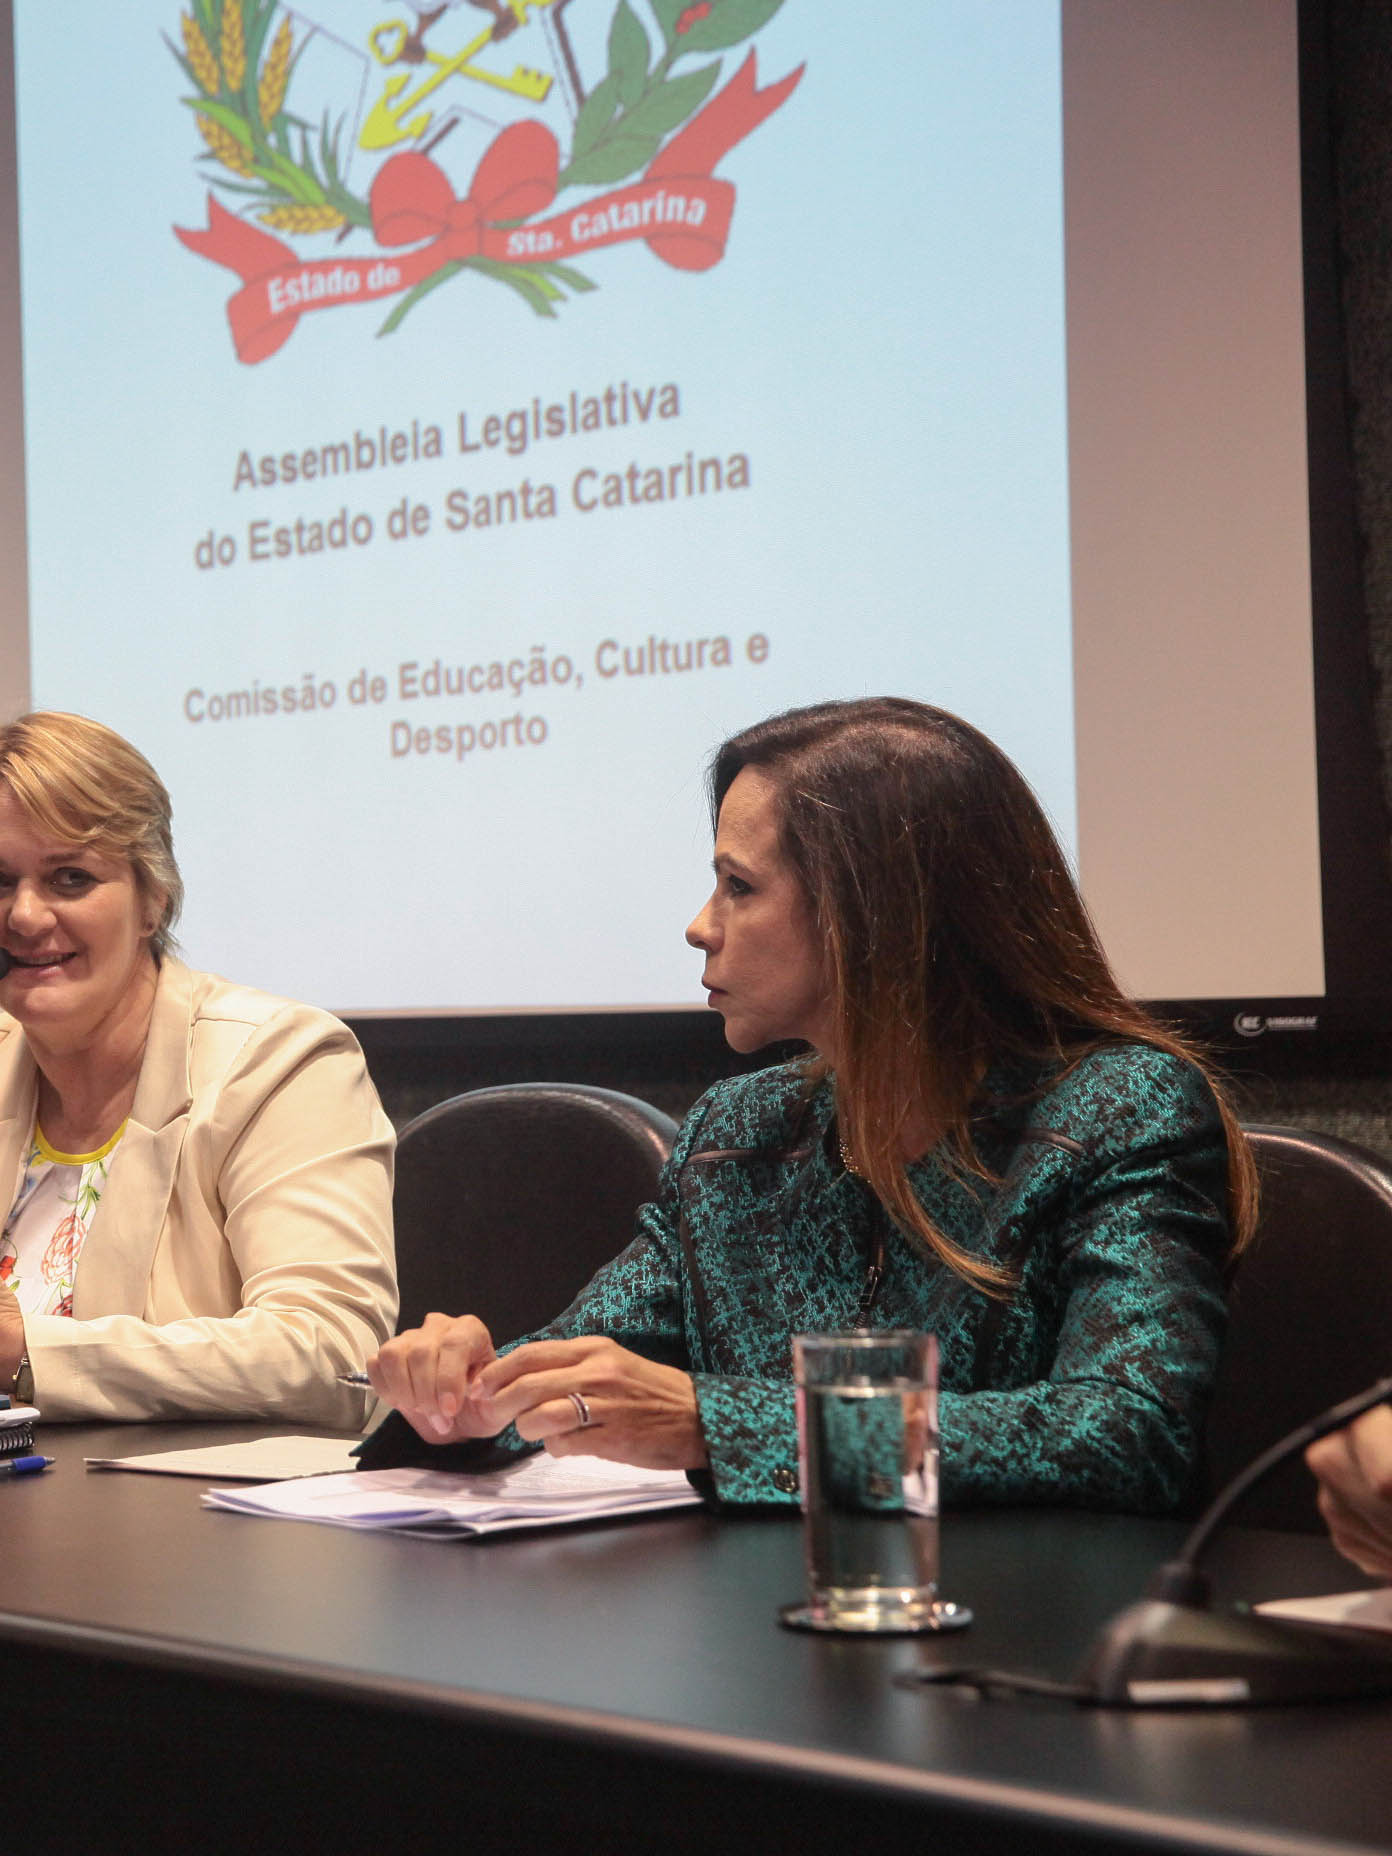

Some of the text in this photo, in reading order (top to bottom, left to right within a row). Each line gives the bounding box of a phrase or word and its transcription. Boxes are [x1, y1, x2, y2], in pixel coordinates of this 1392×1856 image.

[507, 188, 707, 256] Sta. Catarina
[267, 262, 401, 315] Estado de
[233, 381, 681, 491] Assembleia Legislativa
[195, 451, 750, 571] do Estado de Santa Catarina
[184, 632, 771, 724] Comissão de Educação, Cultura e
[390, 711, 549, 763] Desporto
